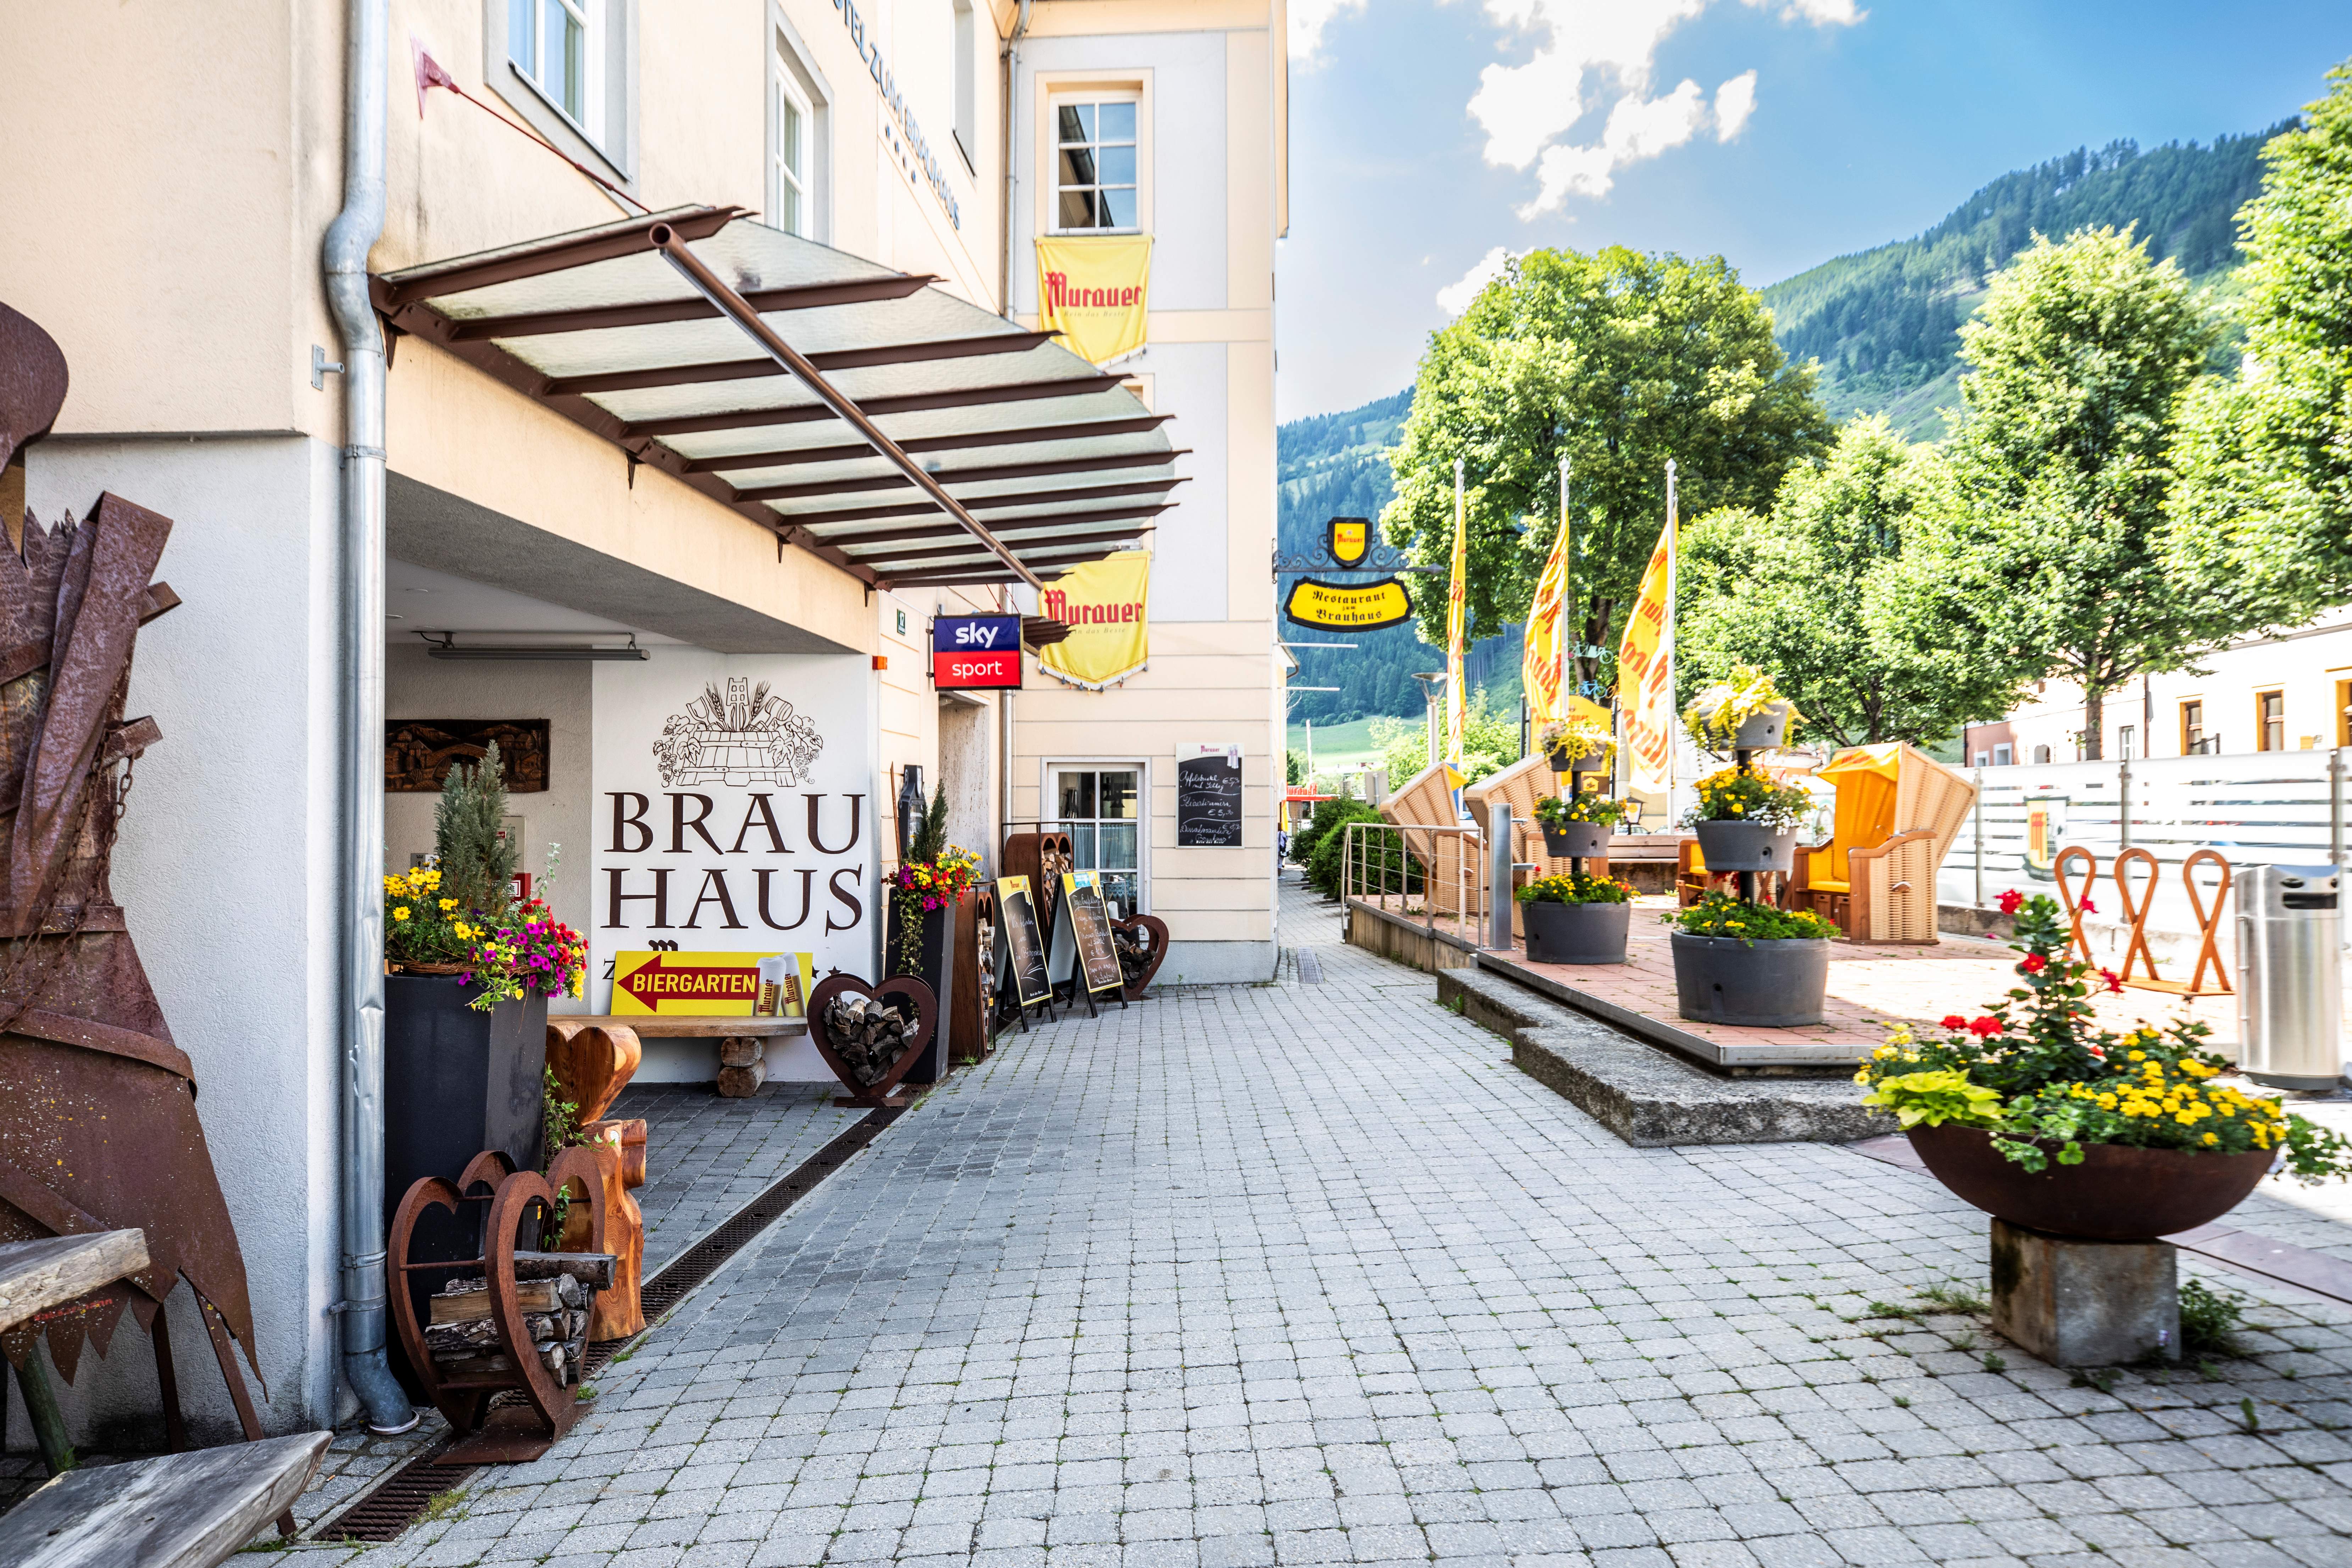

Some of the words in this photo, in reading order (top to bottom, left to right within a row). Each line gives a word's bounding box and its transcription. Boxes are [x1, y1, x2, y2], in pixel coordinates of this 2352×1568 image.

[870, 41, 903, 125] ZUM
[905, 104, 960, 230] BRAUHAUS
[1045, 272, 1142, 317] Murauer
[1337, 533, 1363, 545] Murauer
[1045, 589, 1142, 625] Murauer
[1313, 590, 1385, 604] Restaurant
[1316, 608, 1382, 623] Brauhaus
[955, 622, 999, 649] sky
[952, 661, 1003, 679] sport
[1201, 745, 1220, 754] Murauer
[604, 792, 866, 855] BRAU
[600, 864, 862, 937] HAUS
[633, 974, 756, 992] BIERGARTEN
[757, 979, 773, 1013] Murauer
[784, 973, 799, 1005] Murauer
